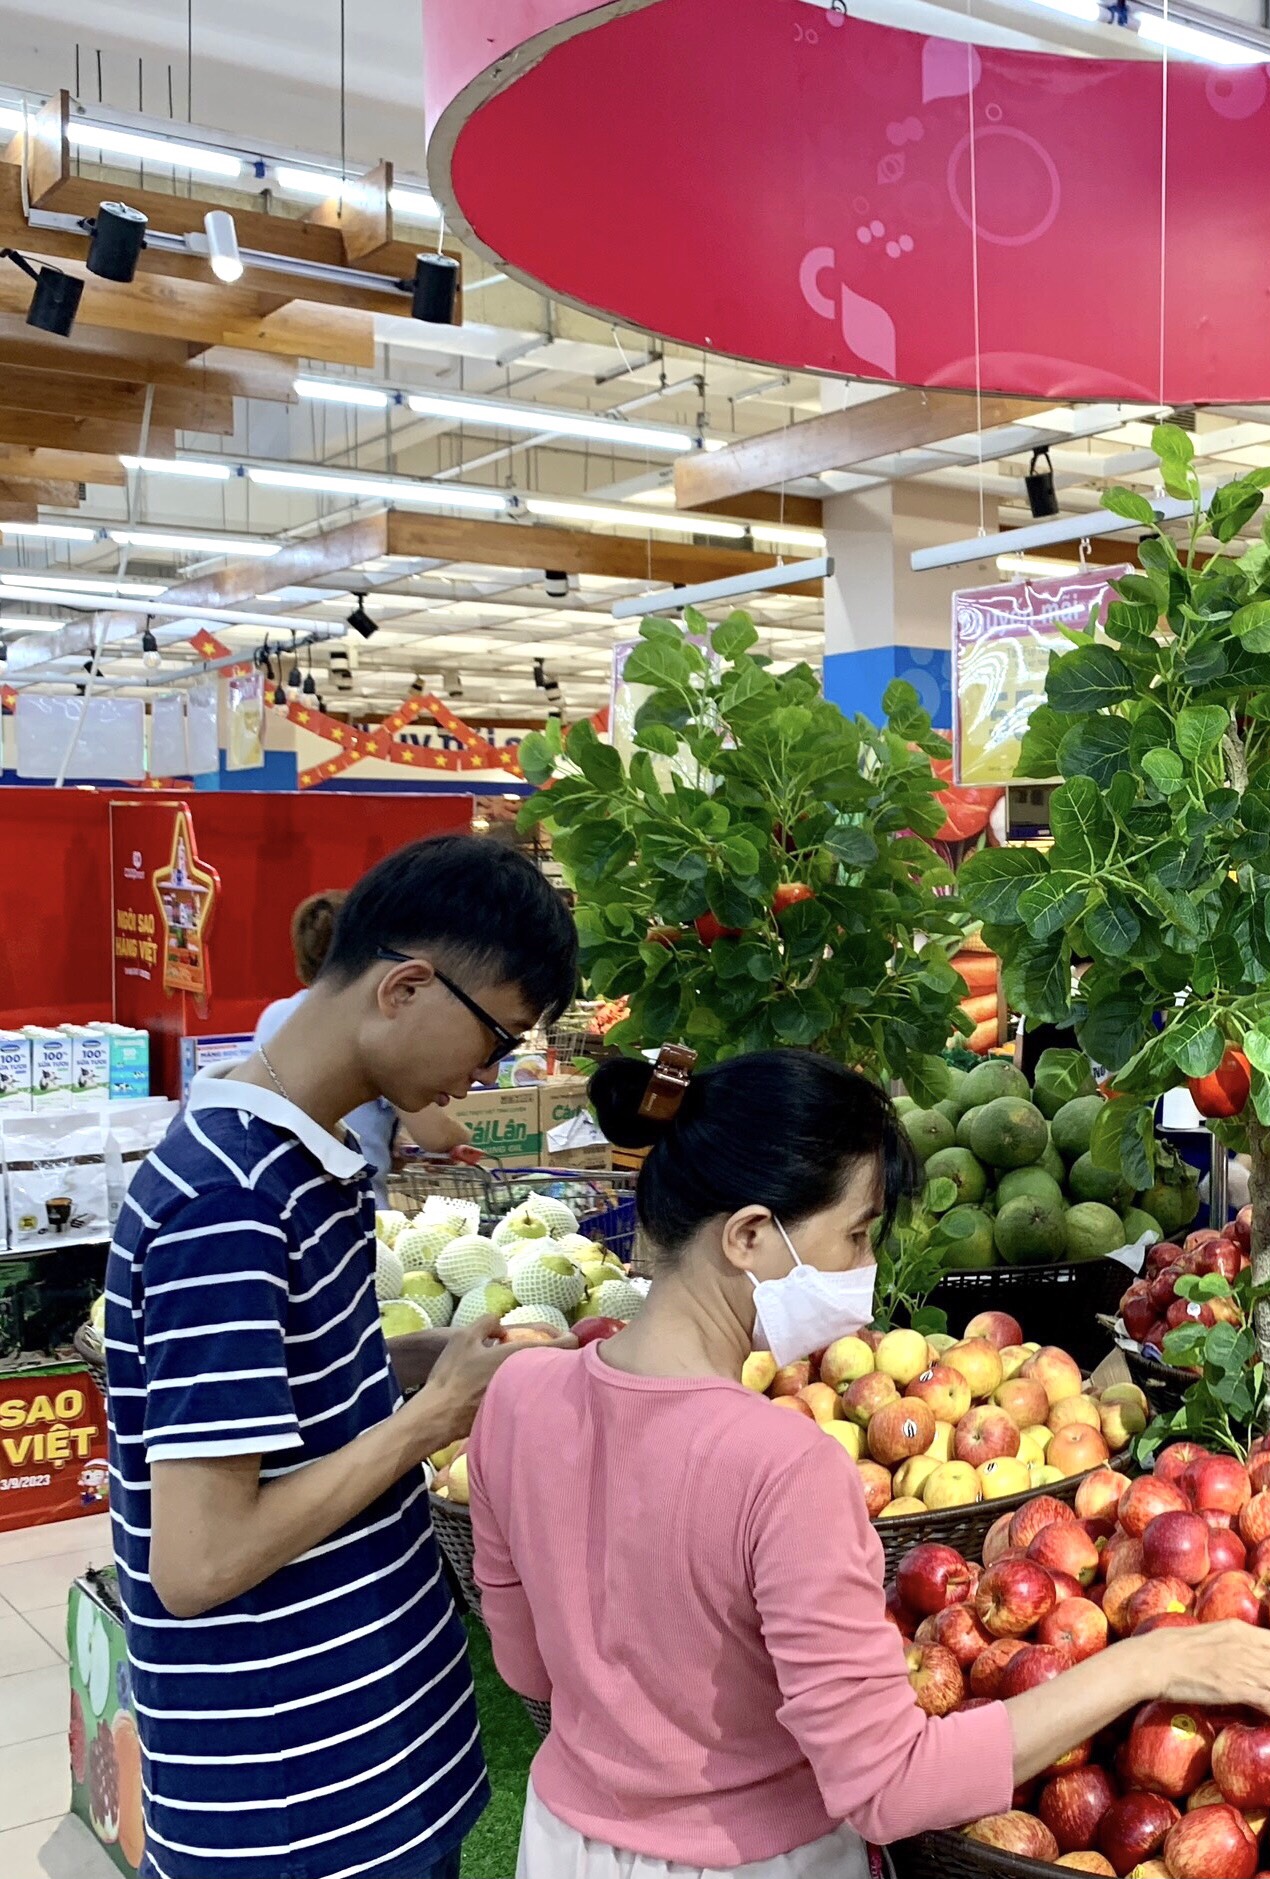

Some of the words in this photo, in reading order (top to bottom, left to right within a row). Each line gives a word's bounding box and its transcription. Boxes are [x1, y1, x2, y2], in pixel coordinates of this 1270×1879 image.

[491, 1118, 527, 1141] Lân
[0, 1389, 84, 1430] SAO
[2, 1423, 99, 1469] VIỆT
